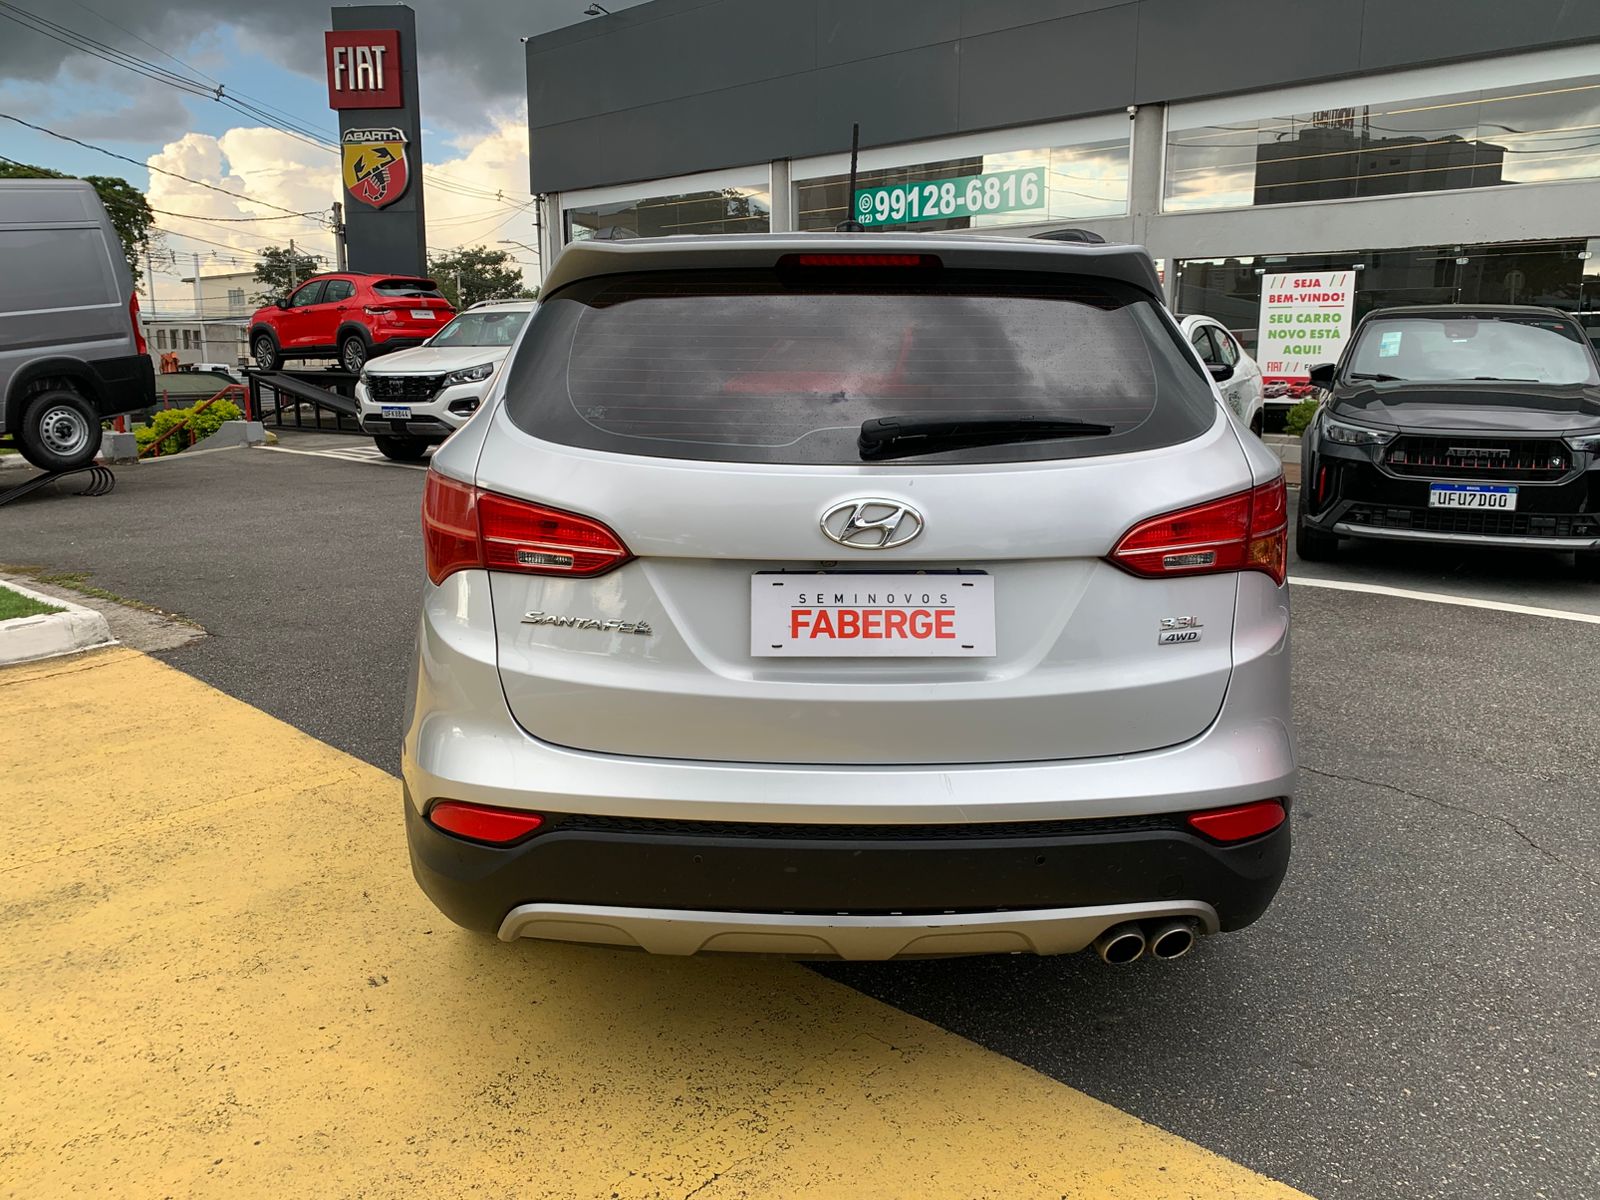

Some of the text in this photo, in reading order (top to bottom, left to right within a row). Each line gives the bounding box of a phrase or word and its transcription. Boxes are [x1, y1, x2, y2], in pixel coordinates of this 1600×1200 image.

[333, 45, 385, 91] FIAT
[345, 131, 400, 142] ABARTH
[874, 172, 1039, 222] 99128-6816
[858, 213, 873, 224] (12)
[1293, 278, 1322, 289] SEJA
[1268, 292, 1345, 304] BEM-VINDO!
[1268, 312, 1342, 324] SEU CARRO
[1267, 326, 1341, 340] NOVO ESTÁ
[1283, 345, 1322, 355] AQUI!
[1266, 361, 1284, 373] FIAT
[1445, 447, 1511, 458] ABARTH
[798, 593, 949, 604] SEMINOVOS
[790, 609, 956, 639] FABERGE
[1164, 631, 1198, 642] 4WD
